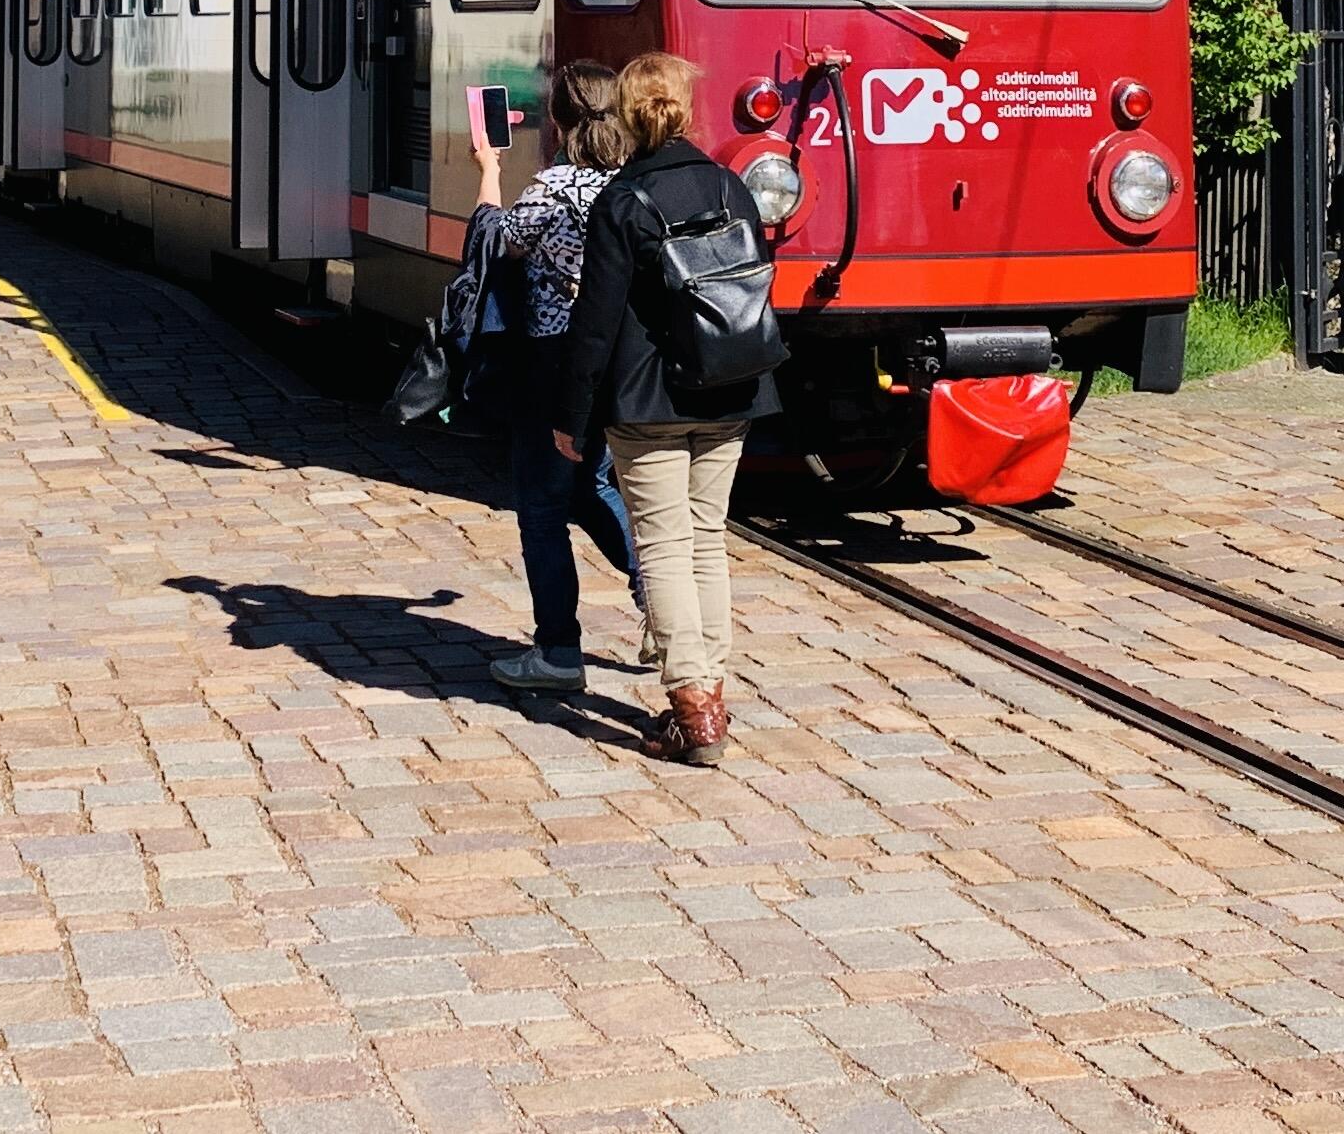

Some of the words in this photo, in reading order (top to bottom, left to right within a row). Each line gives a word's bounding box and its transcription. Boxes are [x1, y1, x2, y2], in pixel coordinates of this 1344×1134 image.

[995, 70, 1079, 86] südtirolmobil
[981, 87, 1097, 104] altoadigemobilità
[997, 103, 1093, 118] südtirolmubiltà
